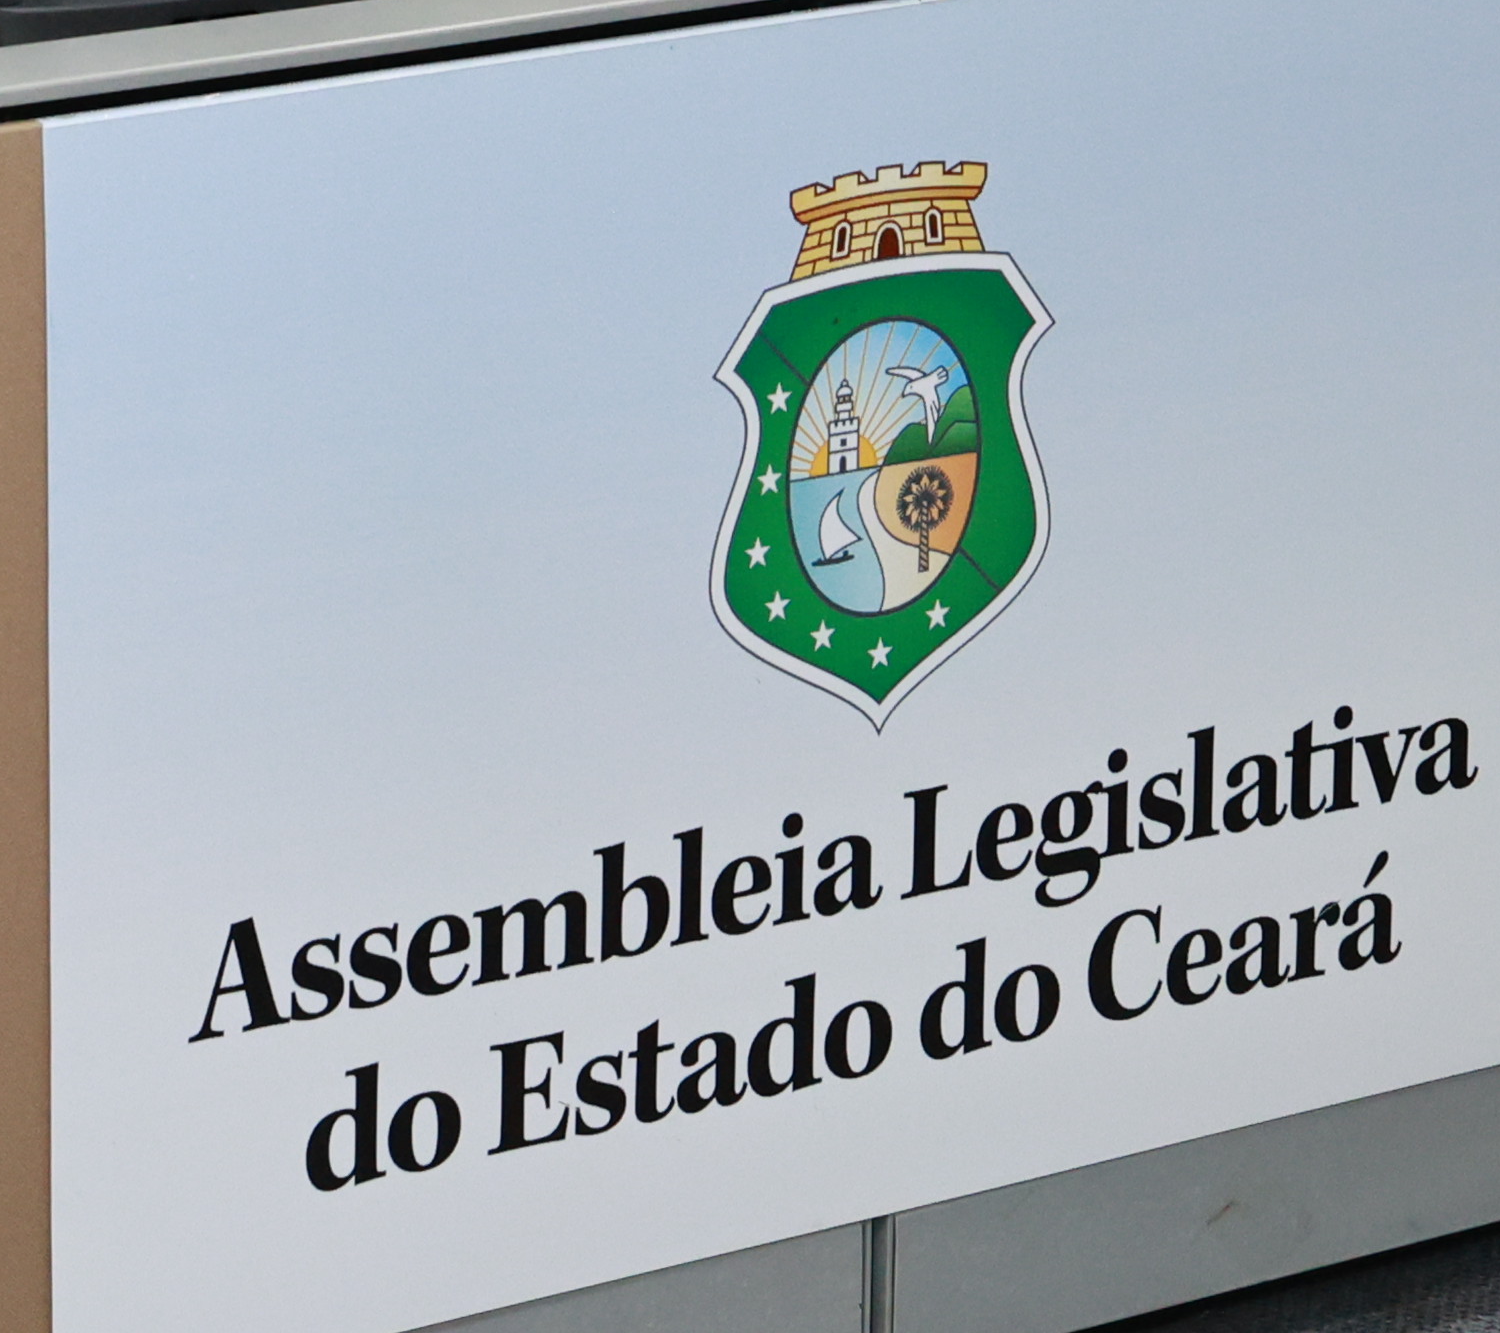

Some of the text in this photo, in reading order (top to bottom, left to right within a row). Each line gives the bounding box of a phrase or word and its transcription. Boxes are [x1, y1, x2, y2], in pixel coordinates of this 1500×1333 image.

[188, 704, 1479, 1043] Assembleia Legislativa
[305, 850, 1402, 1192] do Estado do Ceará
